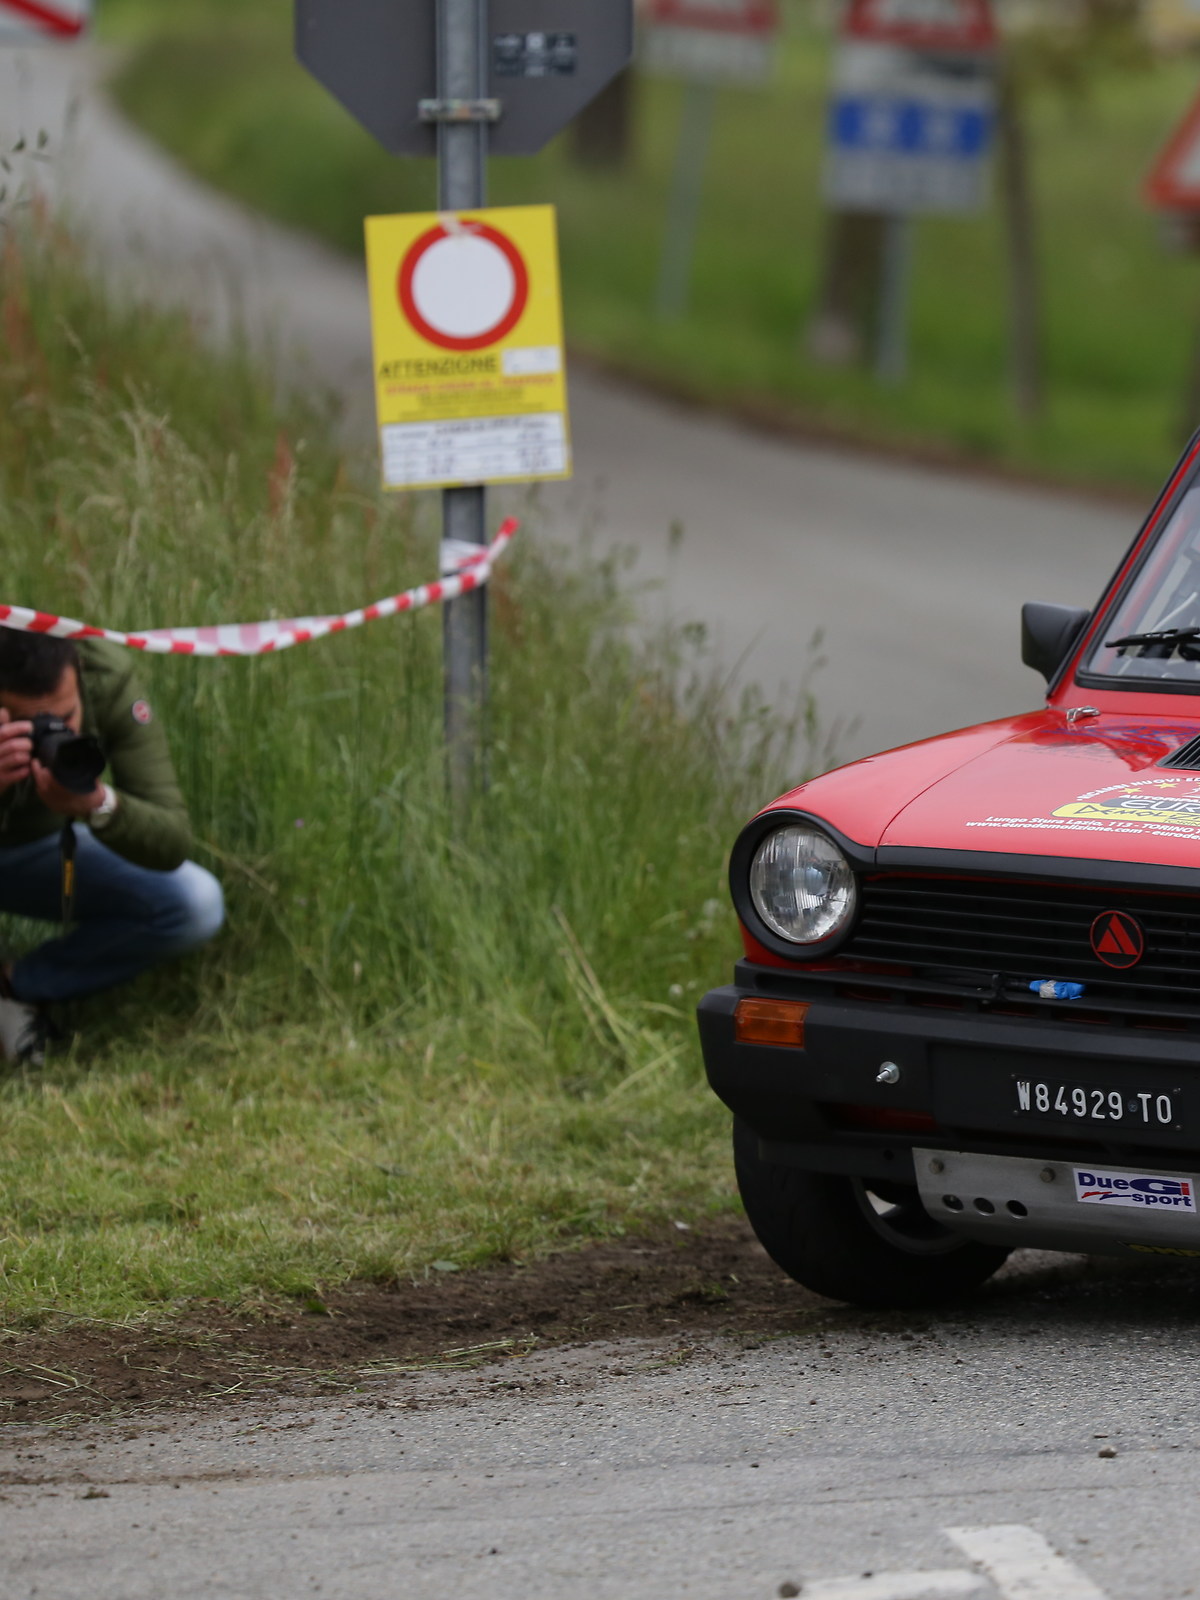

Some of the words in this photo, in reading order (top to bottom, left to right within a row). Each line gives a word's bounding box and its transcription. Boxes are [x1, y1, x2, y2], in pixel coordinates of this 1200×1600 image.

[379, 355, 497, 378] ATTENZIONE
[1130, 778, 1181, 787] NUOVI
[985, 816, 1028, 824] Lungo
[1029, 817, 1065, 825] Stura
[1142, 823, 1198, 834] TORINO
[1017, 1081, 1123, 1121] W84929
[1137, 1093, 1172, 1124] TO
[1077, 1172, 1190, 1197] DueGi
[1131, 1193, 1192, 1207] sport
